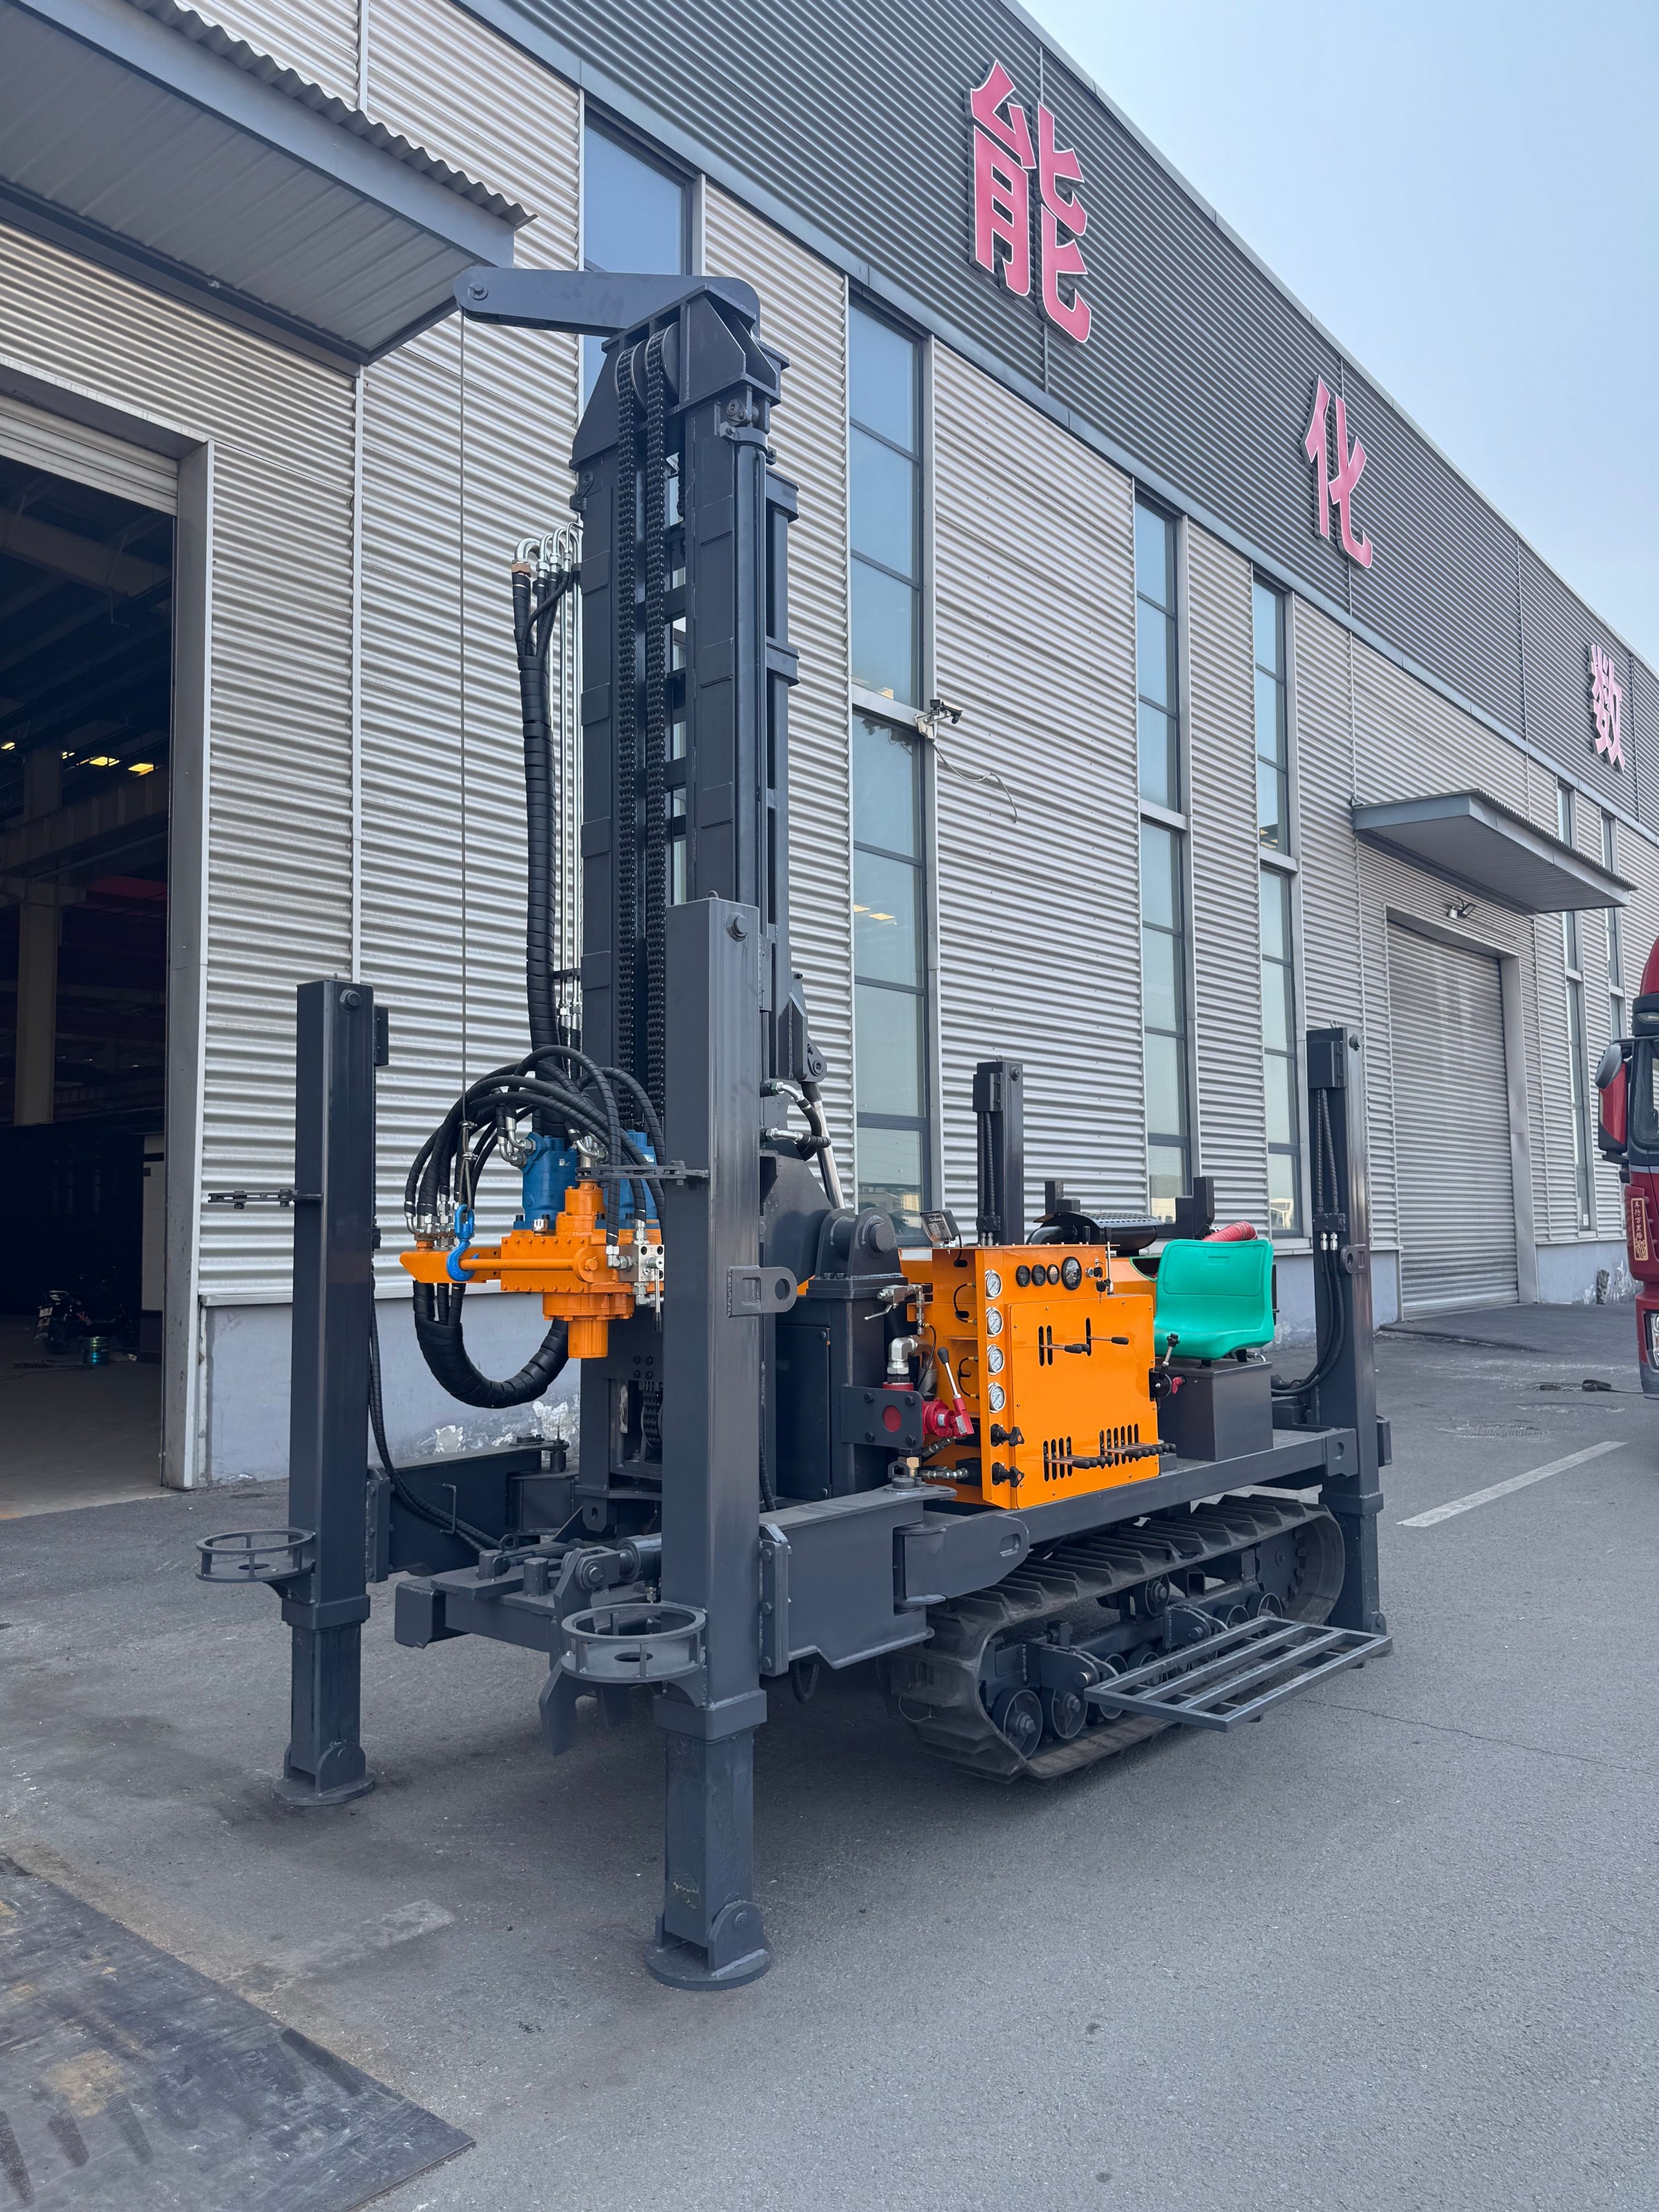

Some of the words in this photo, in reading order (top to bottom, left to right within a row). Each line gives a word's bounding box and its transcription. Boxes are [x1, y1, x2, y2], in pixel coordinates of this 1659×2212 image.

[970, 58, 1092, 344] 能
[1304, 373, 1374, 569] 化
[1590, 644, 1626, 774] 数
